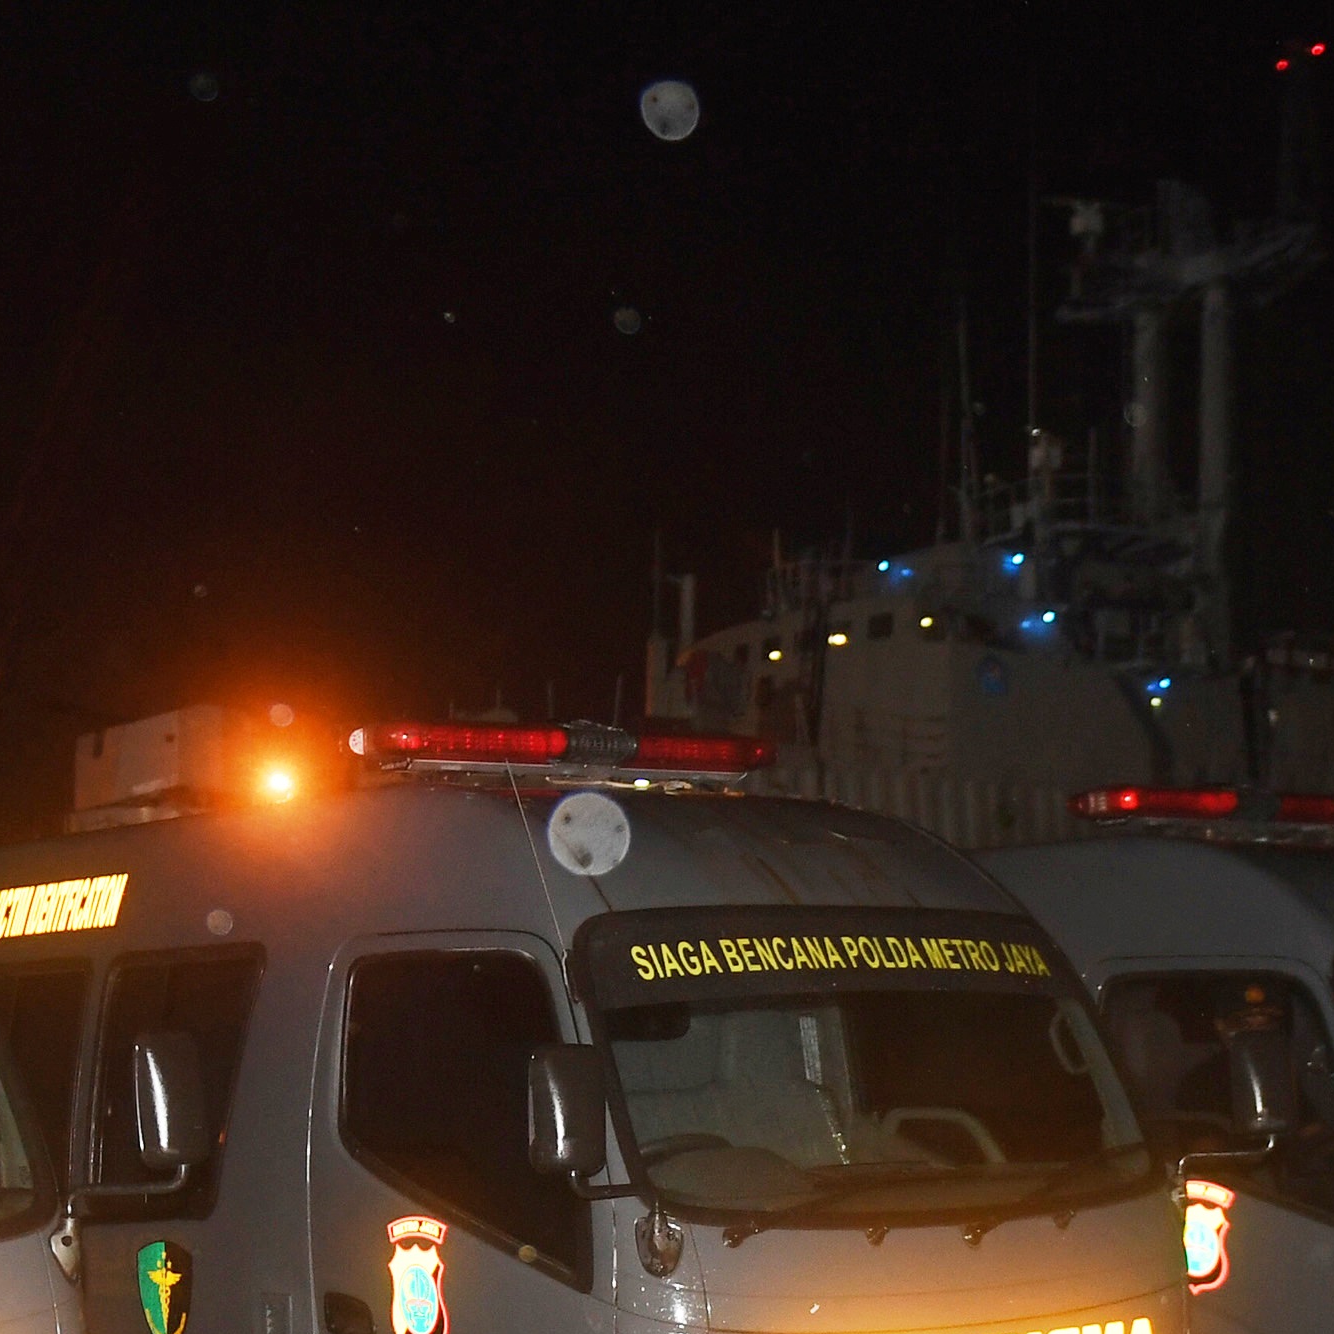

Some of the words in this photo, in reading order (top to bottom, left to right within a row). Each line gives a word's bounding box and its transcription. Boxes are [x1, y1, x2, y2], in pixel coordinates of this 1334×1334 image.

[630, 940, 724, 981] SIAGA
[718, 936, 847, 974] BENCANA
[841, 936, 928, 970] POLDA
[921, 937, 1001, 972] METRO
[1003, 941, 1052, 978] JAYA
